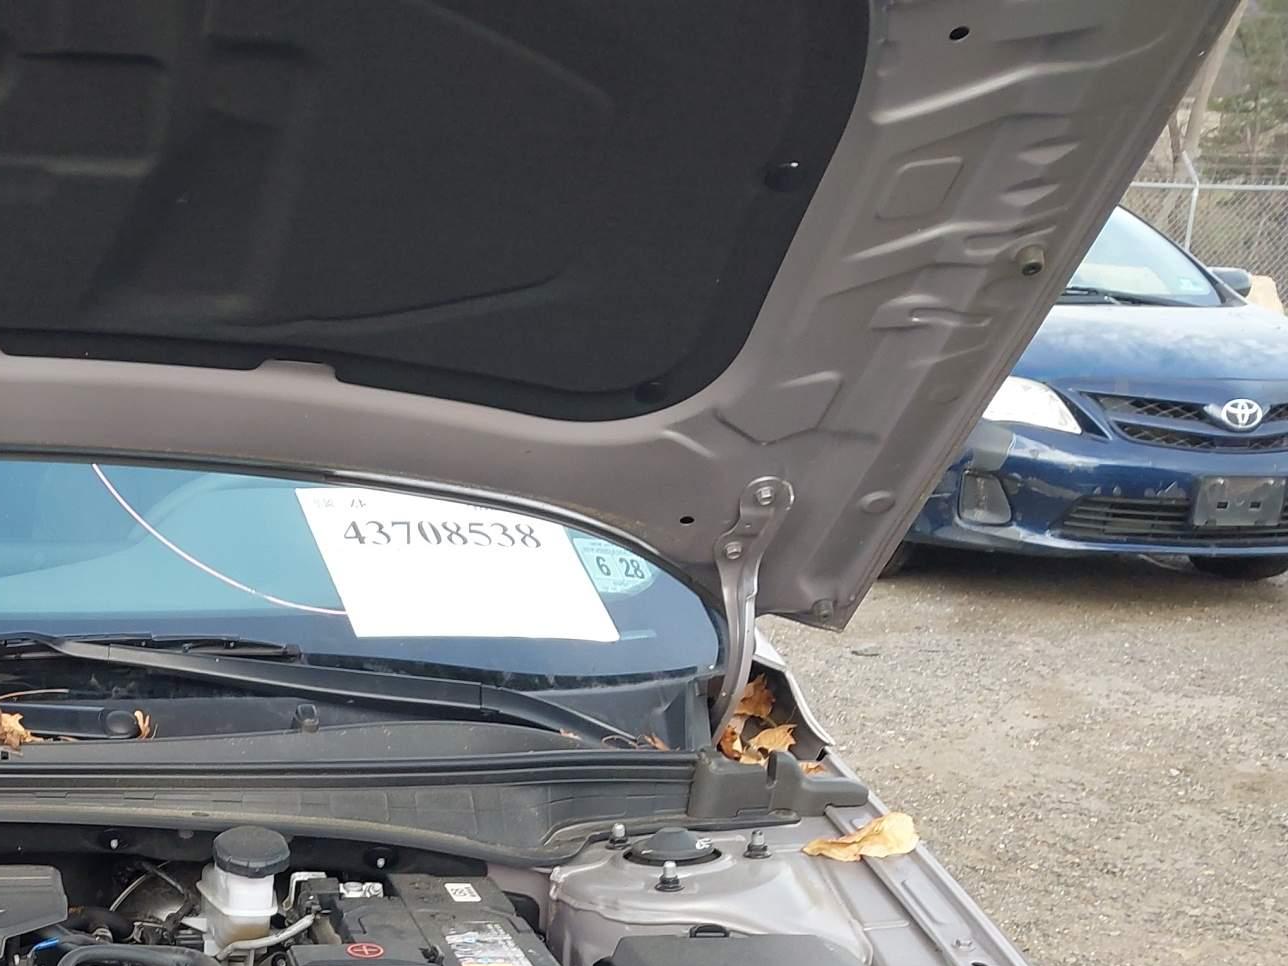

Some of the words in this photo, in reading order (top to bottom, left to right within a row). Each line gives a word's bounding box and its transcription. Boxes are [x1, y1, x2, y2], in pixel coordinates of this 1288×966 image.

[344, 520, 541, 548] 43708538
[596, 555, 611, 577] 6
[619, 557, 645, 579] 28
